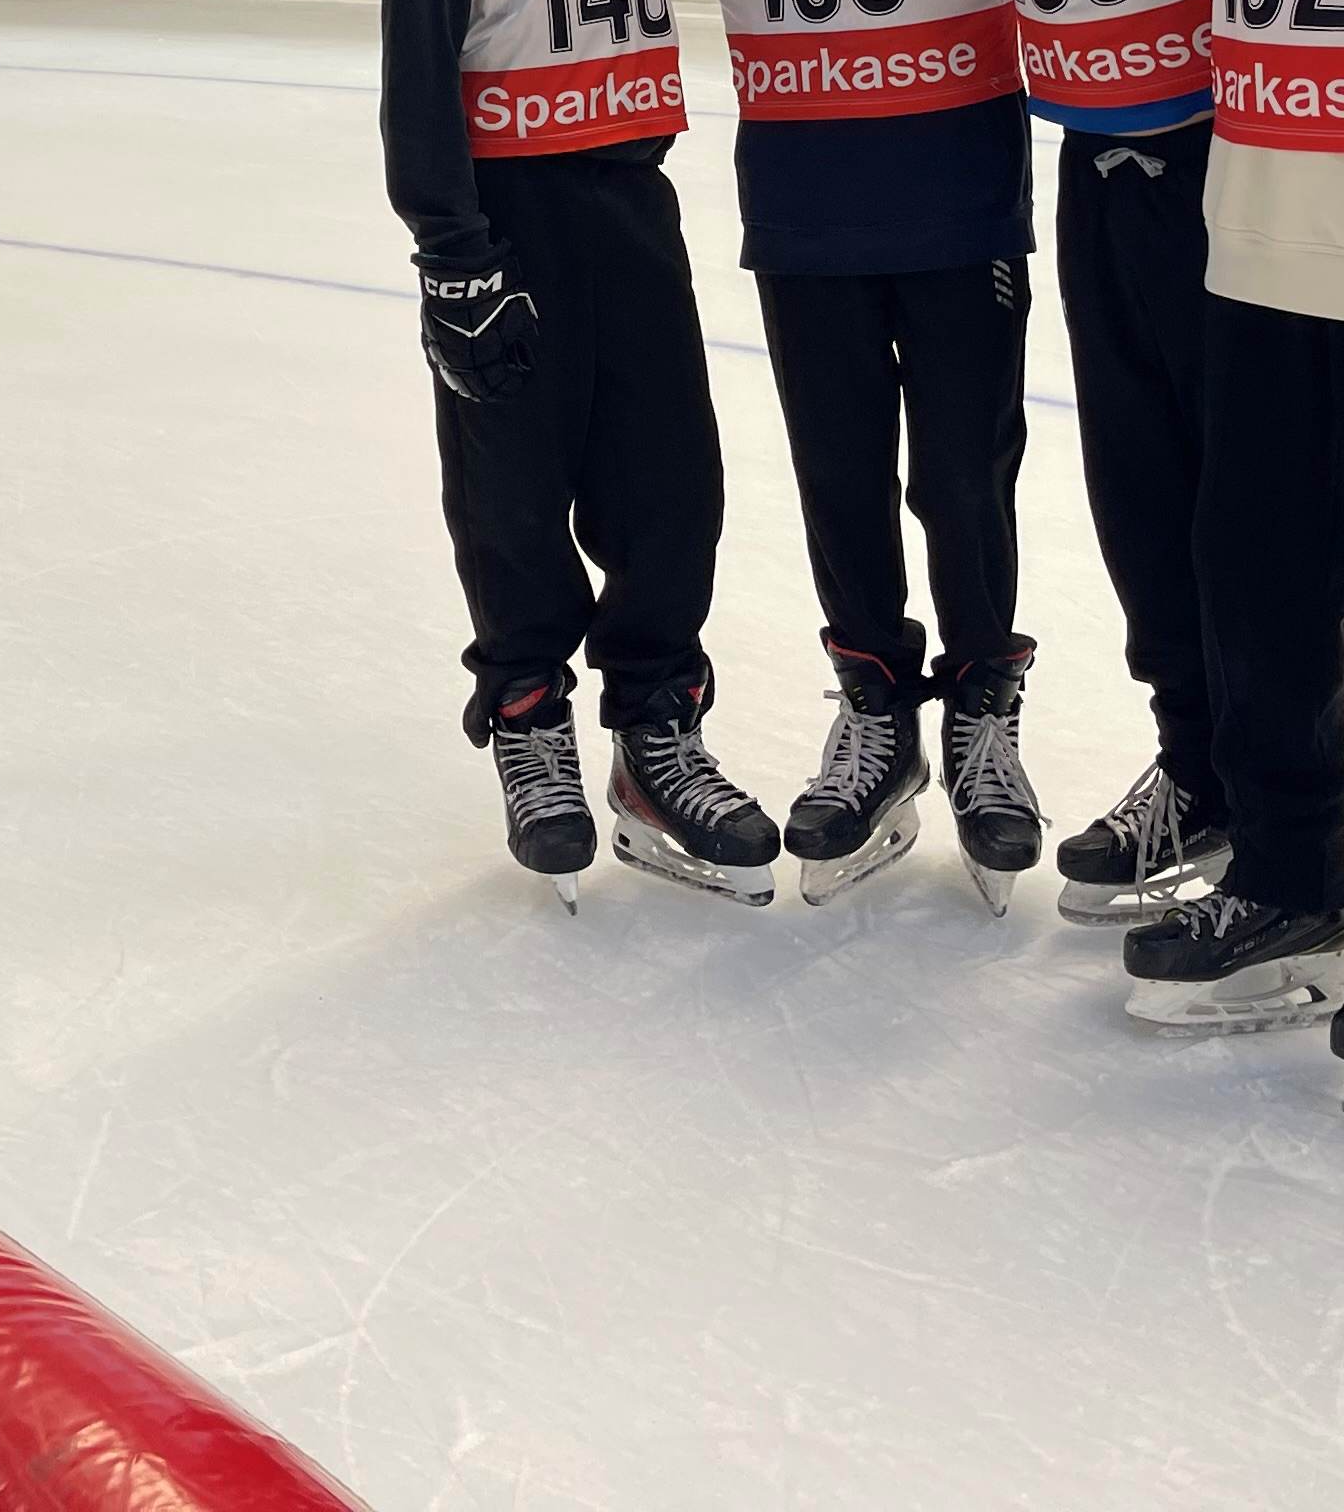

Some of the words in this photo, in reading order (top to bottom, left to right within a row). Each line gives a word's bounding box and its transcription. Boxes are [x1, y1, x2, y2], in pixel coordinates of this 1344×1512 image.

[1022, 22, 1212, 82] arkasse
[473, 71, 683, 139] Sparkas
[424, 270, 503, 299] CCM
